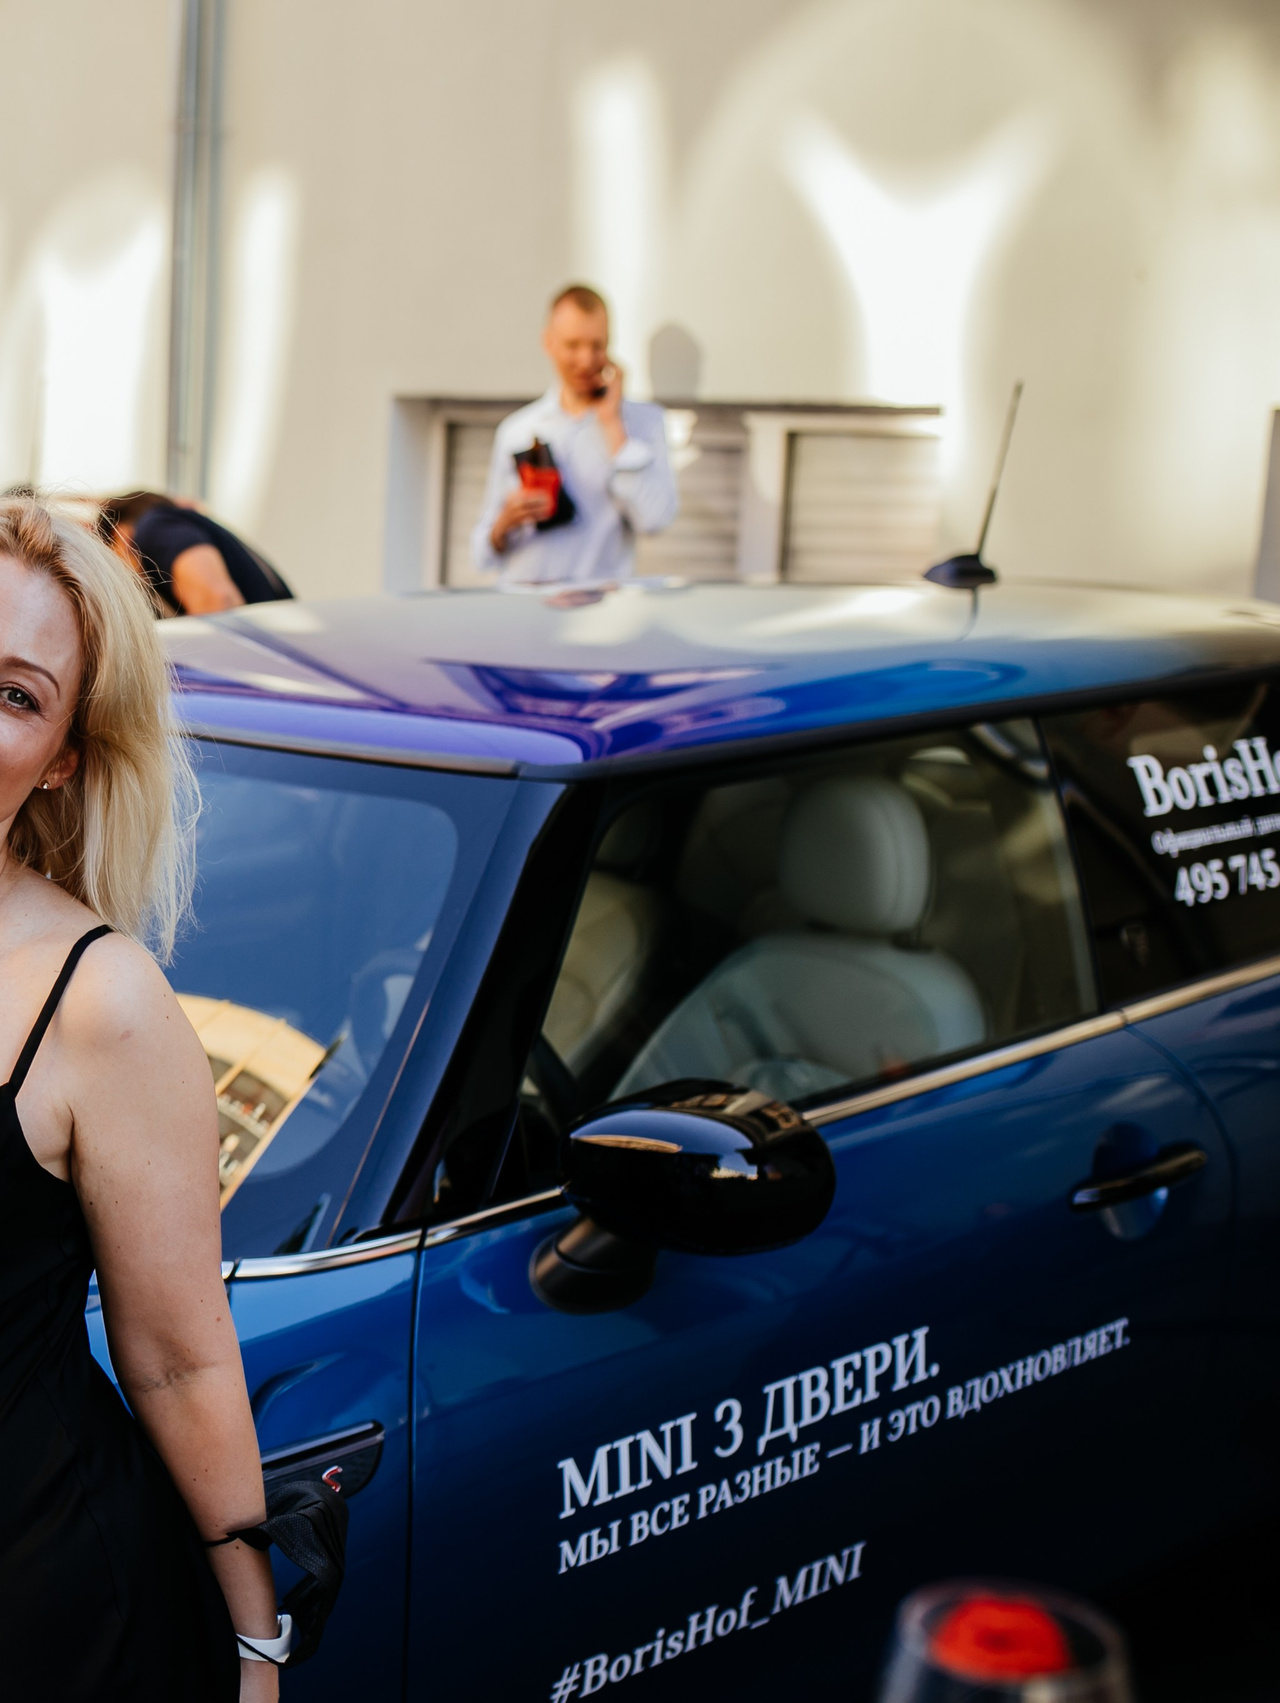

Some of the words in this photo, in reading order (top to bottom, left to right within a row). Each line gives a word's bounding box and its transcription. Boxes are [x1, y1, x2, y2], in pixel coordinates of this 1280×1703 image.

[1126, 736, 1280, 817] BorisH
[1175, 859, 1229, 906] 495
[1228, 848, 1280, 894] 745
[557, 1413, 699, 1520] MINI
[714, 1399, 744, 1458] 3
[757, 1326, 940, 1456] ДВЕРИ.
[558, 1520, 622, 1574] МЫ
[629, 1492, 691, 1546] ВСЕ
[697, 1442, 820, 1519] РАЗНЫЕ
[859, 1418, 882, 1455] И
[887, 1395, 941, 1442] ЭТО
[946, 1317, 1131, 1420] ВДОХНОВЛЯЕТ.
[550, 1541, 866, 1703] #BorisHof_MINI
